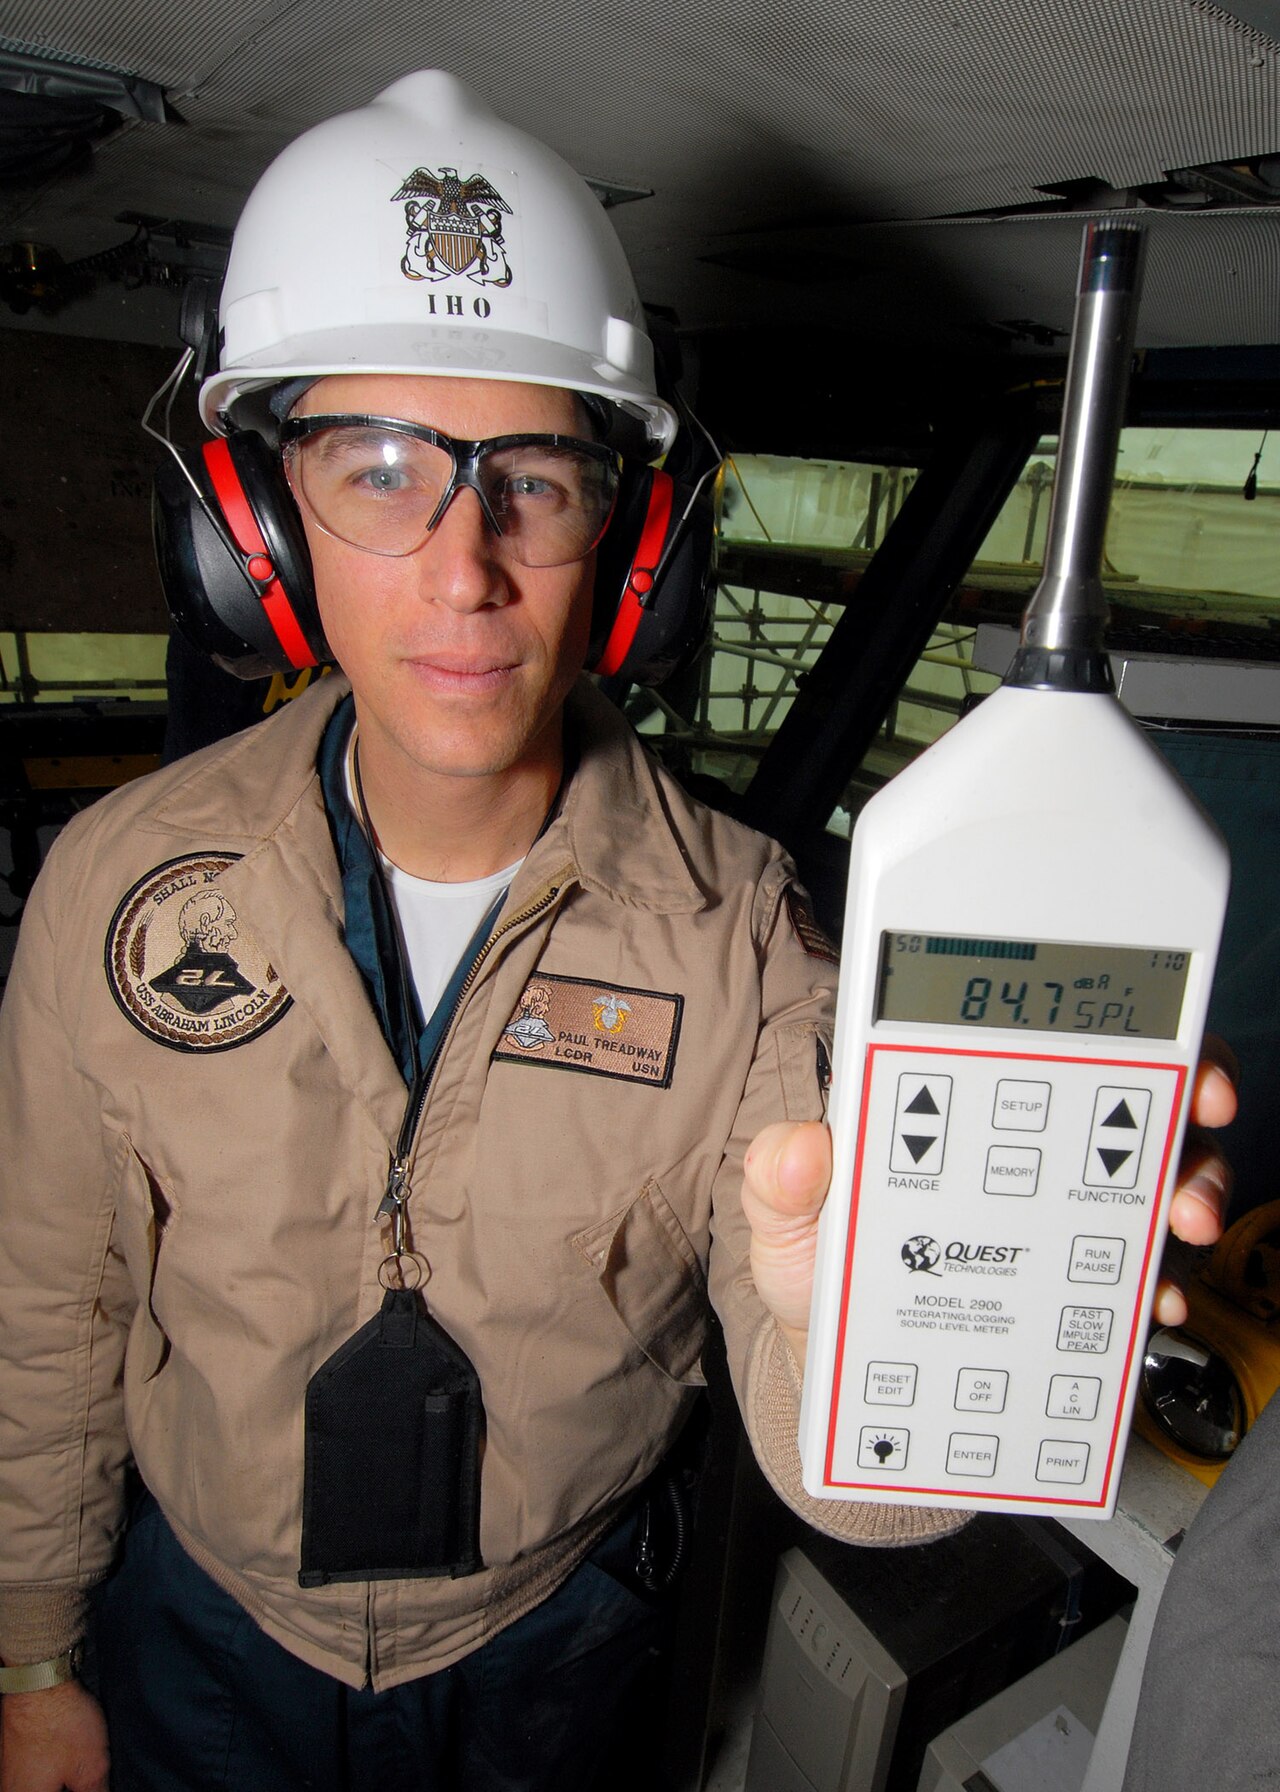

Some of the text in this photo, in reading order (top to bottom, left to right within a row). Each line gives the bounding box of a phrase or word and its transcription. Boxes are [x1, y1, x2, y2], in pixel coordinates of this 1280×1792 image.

[427, 294, 491, 318] IHO
[153, 871, 220, 906] SHALL N
[896, 935, 921, 953] 50
[1151, 953, 1185, 971] 110
[136, 982, 271, 1032] USS ABRAHAM LINCOLN
[960, 977, 1065, 1026] 84.7
[1073, 1001, 1141, 1033] SPL
[557, 1031, 663, 1061] PAUL TREADWAY
[555, 1046, 593, 1062] LCDR
[632, 1062, 660, 1076] USN
[1000, 1100, 1043, 1113] SETUP
[990, 1165, 1035, 1178] MEMORY
[887, 1177, 940, 1191] RANGE
[1068, 1189, 1146, 1206] FUNCTION
[945, 1241, 1023, 1264] QUEST
[1084, 1248, 1111, 1260] RUN
[943, 1262, 1018, 1277] TECHNOLOGIES
[1075, 1261, 1116, 1273] PAUSE
[914, 1295, 1003, 1312] MODEL 2900
[896, 1308, 1016, 1325] INTEGRATING/LOGGING
[1072, 1309, 1103, 1320] FAST
[900, 1319, 1009, 1335] SOUND LEVEL METER
[1068, 1320, 1104, 1330] SLOW
[1062, 1330, 1105, 1341] IMPULSE
[1066, 1341, 1098, 1351] PEAK
[872, 1373, 911, 1384] RESET
[973, 1380, 992, 1390] ON
[877, 1385, 903, 1395] EDIT
[1071, 1382, 1080, 1391] A
[969, 1392, 993, 1402] OFF
[1069, 1394, 1078, 1403] C
[1063, 1405, 1081, 1415] LIN
[953, 1450, 992, 1461] ENTER
[1046, 1457, 1080, 1468] PRINT
